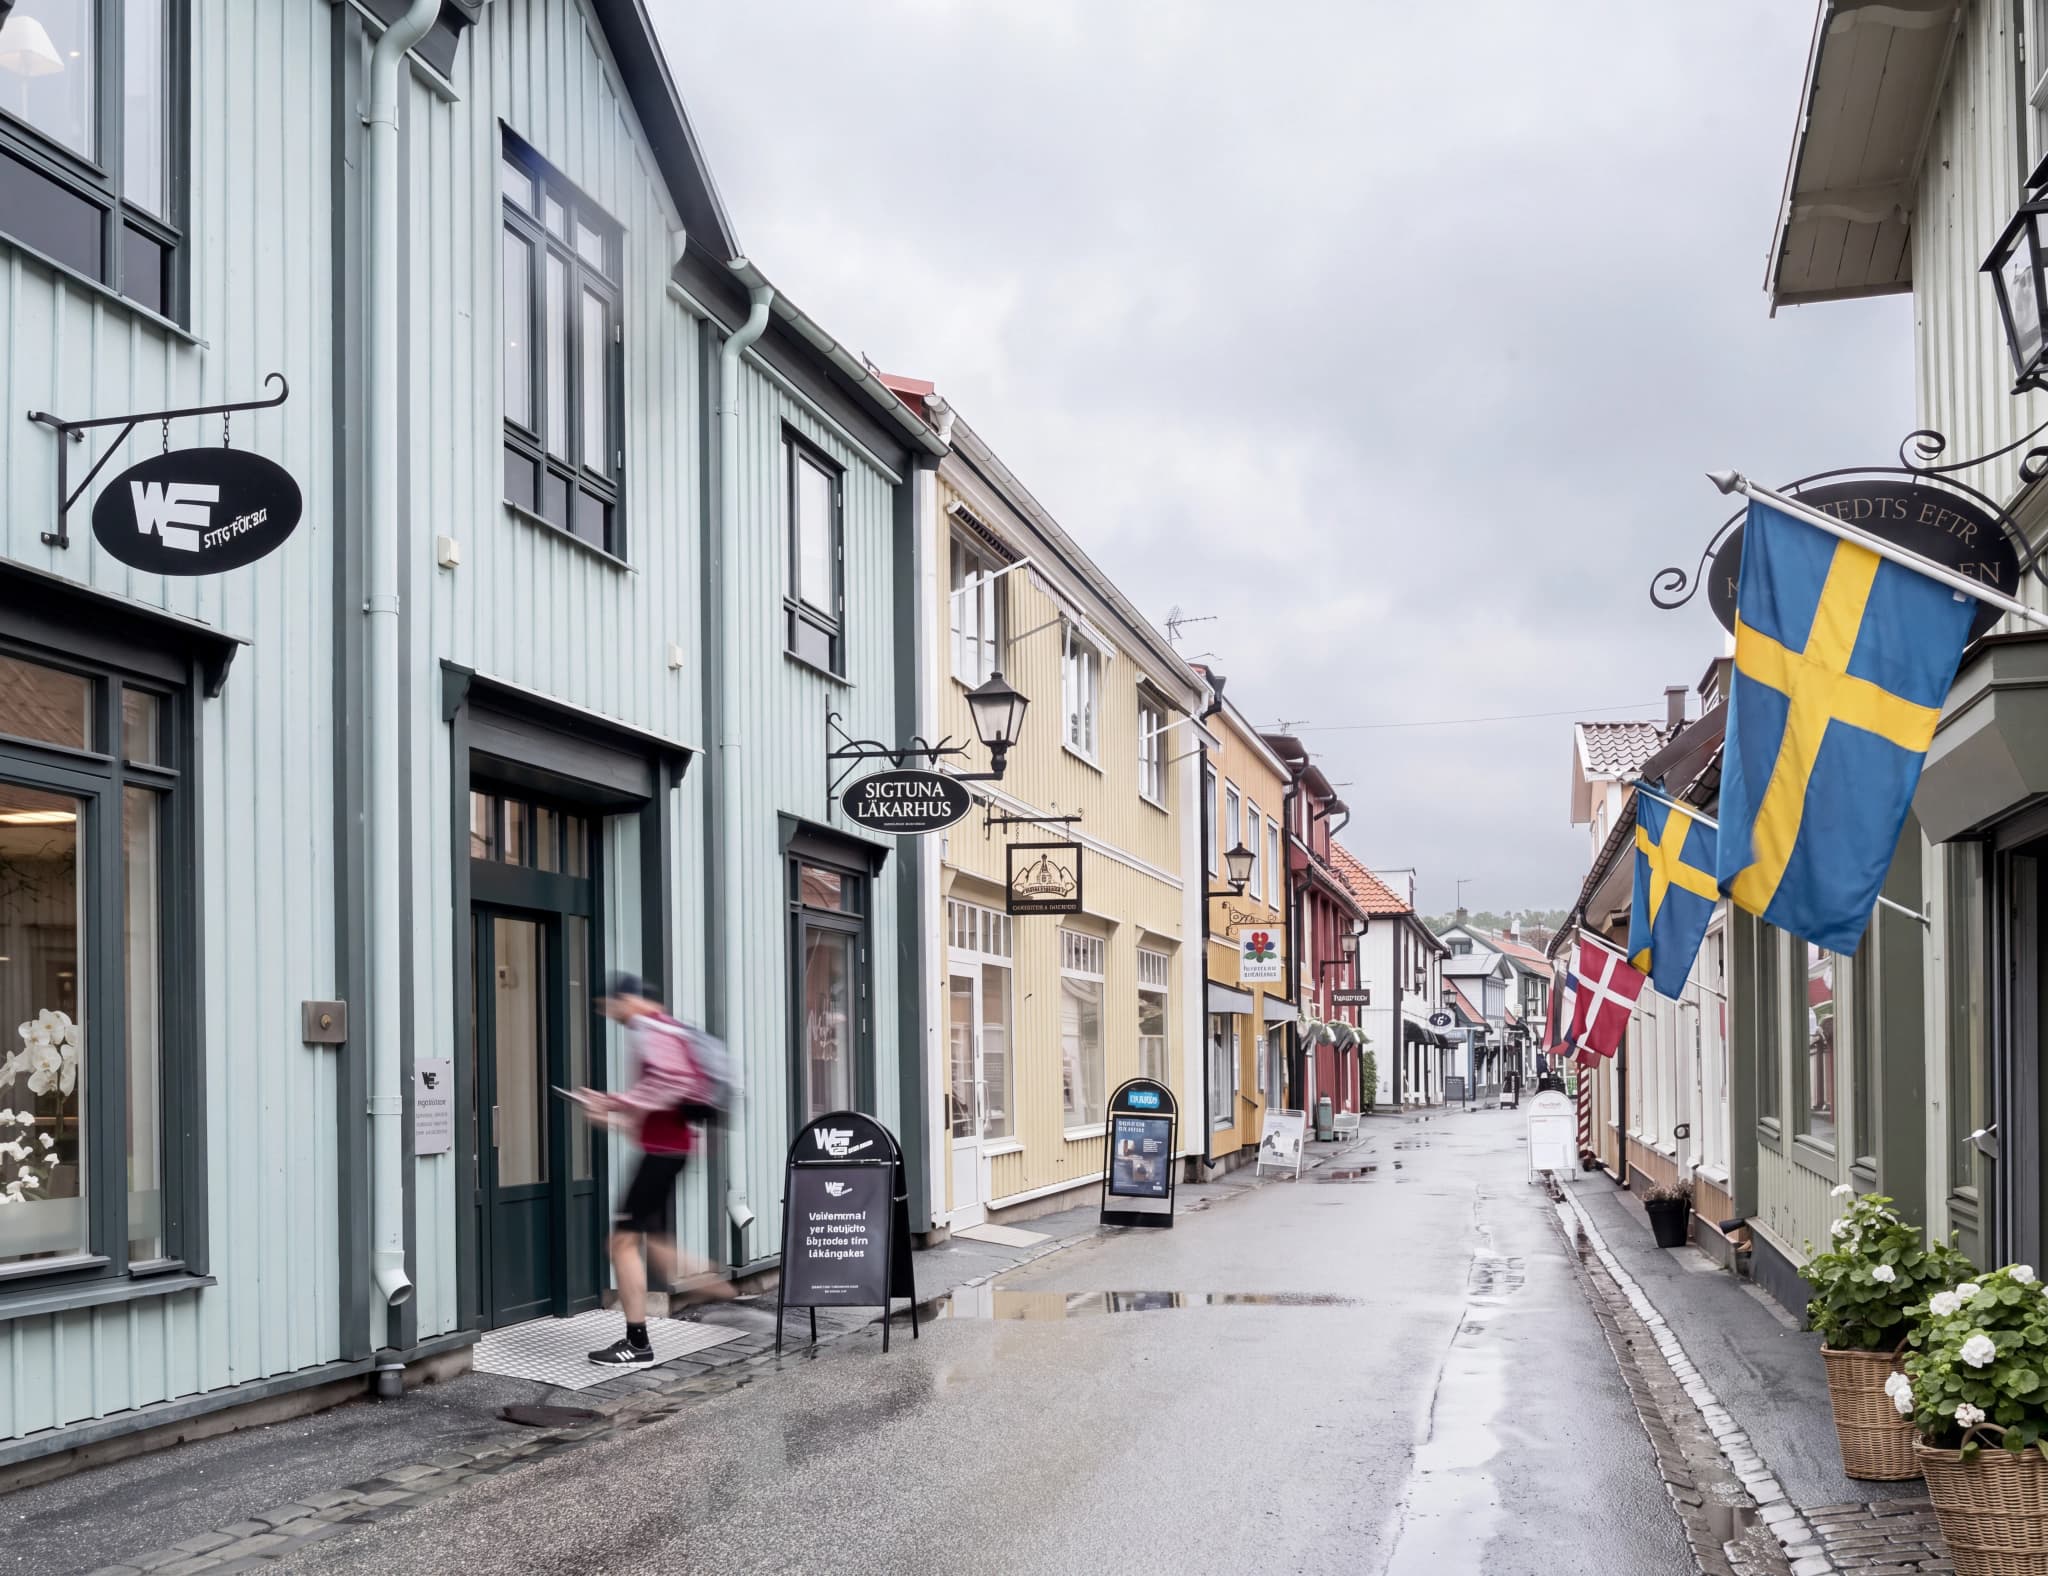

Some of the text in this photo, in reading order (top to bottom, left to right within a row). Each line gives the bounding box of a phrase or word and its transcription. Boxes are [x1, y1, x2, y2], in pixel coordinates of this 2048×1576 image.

[1916, 503, 1977, 549] EFTR.
[865, 782, 944, 798] SIGTUNA
[858, 800, 951, 817] LÄKARHUS
